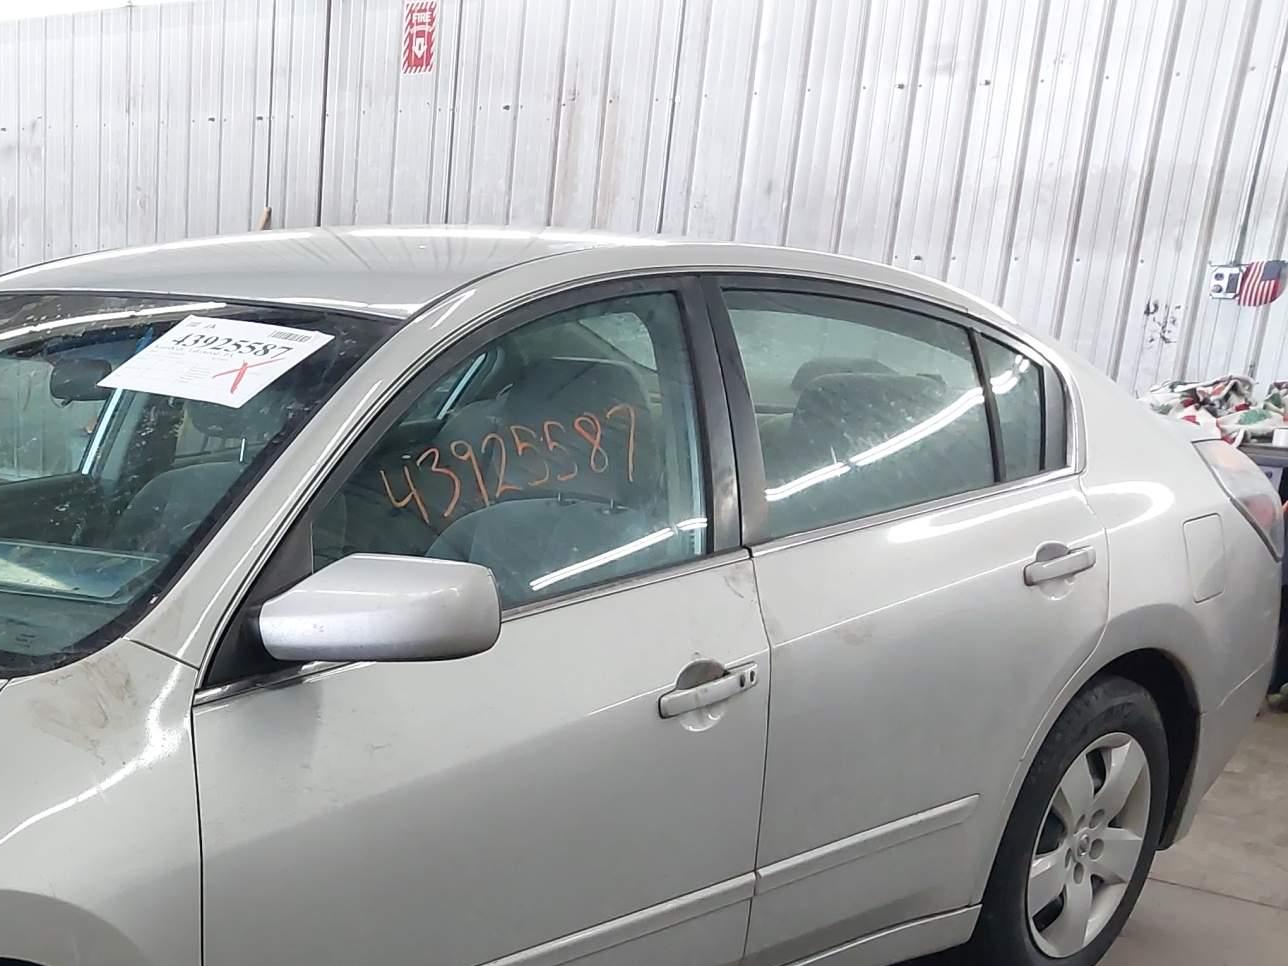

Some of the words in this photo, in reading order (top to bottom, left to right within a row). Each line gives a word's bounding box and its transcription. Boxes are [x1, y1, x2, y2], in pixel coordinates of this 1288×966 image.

[412, 12, 433, 23] FIRE
[171, 332, 294, 359] 43925587
[379, 403, 637, 526] 43925587
